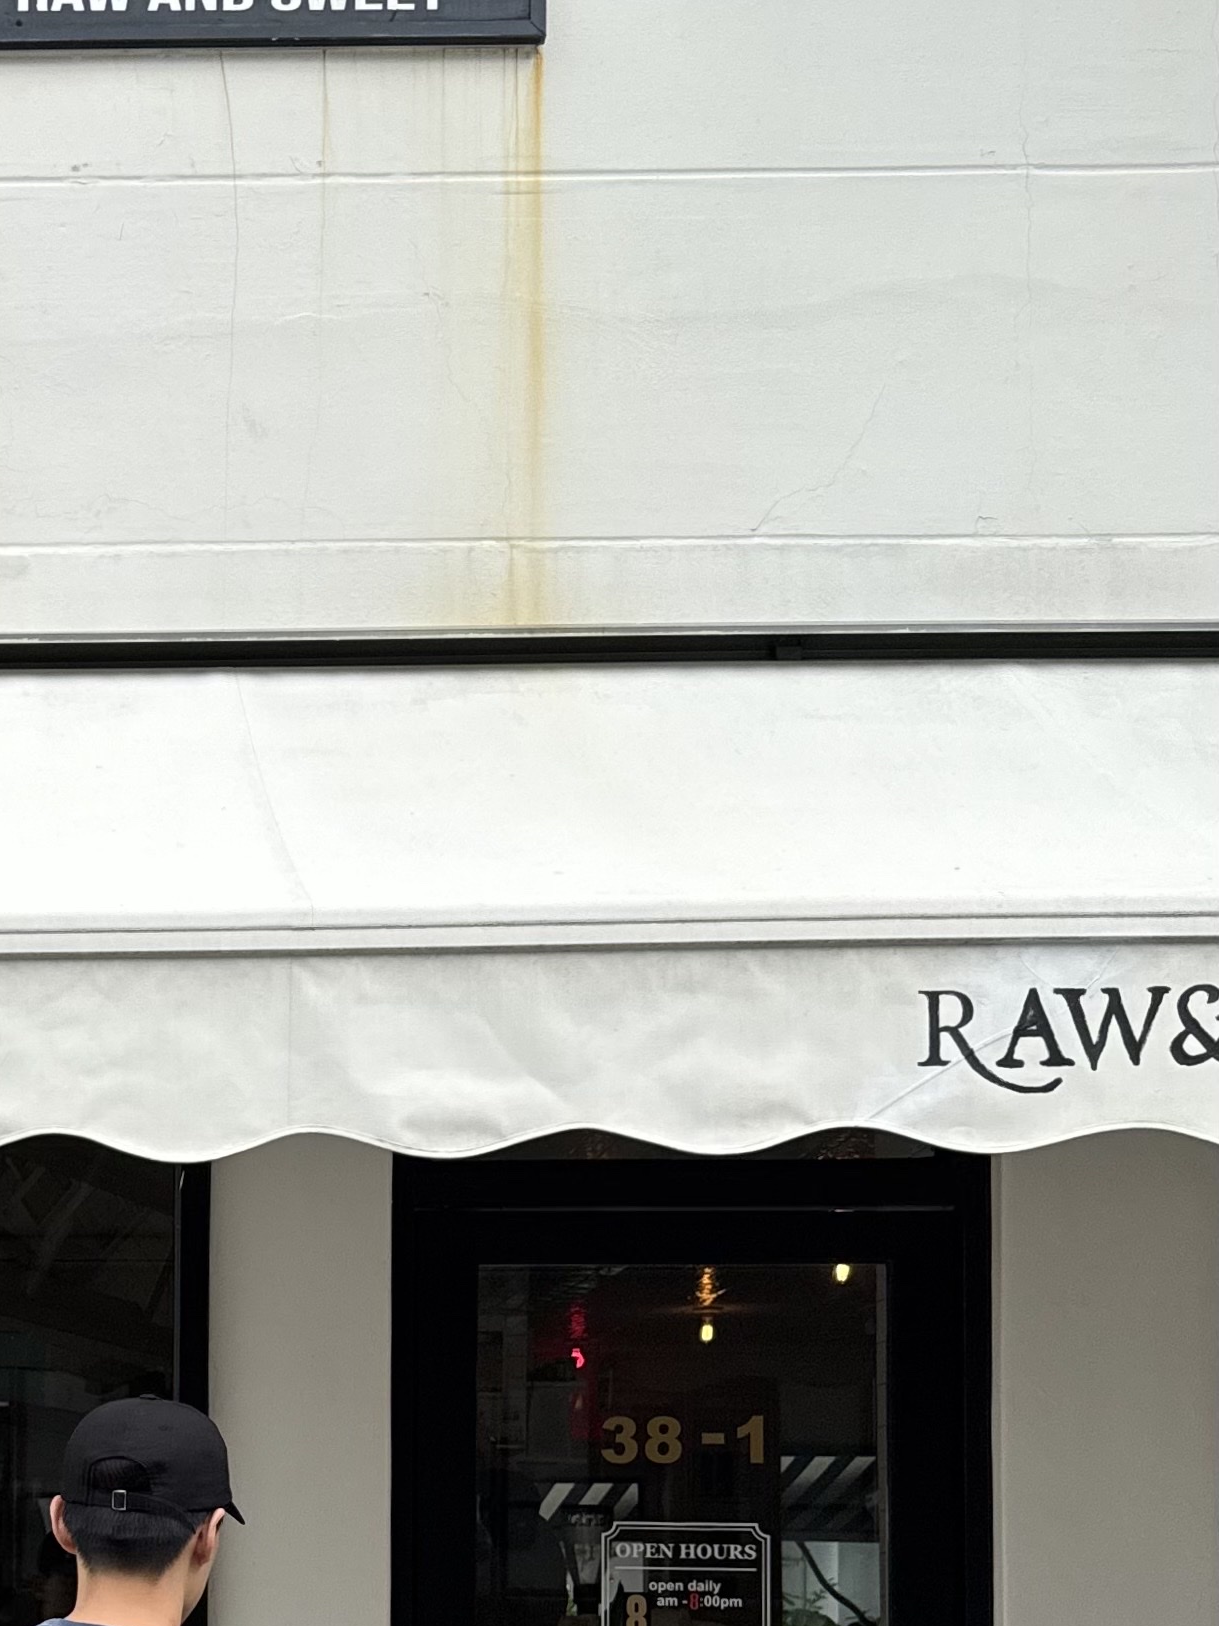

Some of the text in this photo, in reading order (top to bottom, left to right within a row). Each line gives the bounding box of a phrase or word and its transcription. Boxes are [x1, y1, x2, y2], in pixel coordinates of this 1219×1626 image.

[615, 1543, 757, 1560] OPEN HOURS
[648, 1579, 721, 1595] open daily
[656, 1597, 679, 1607] am
